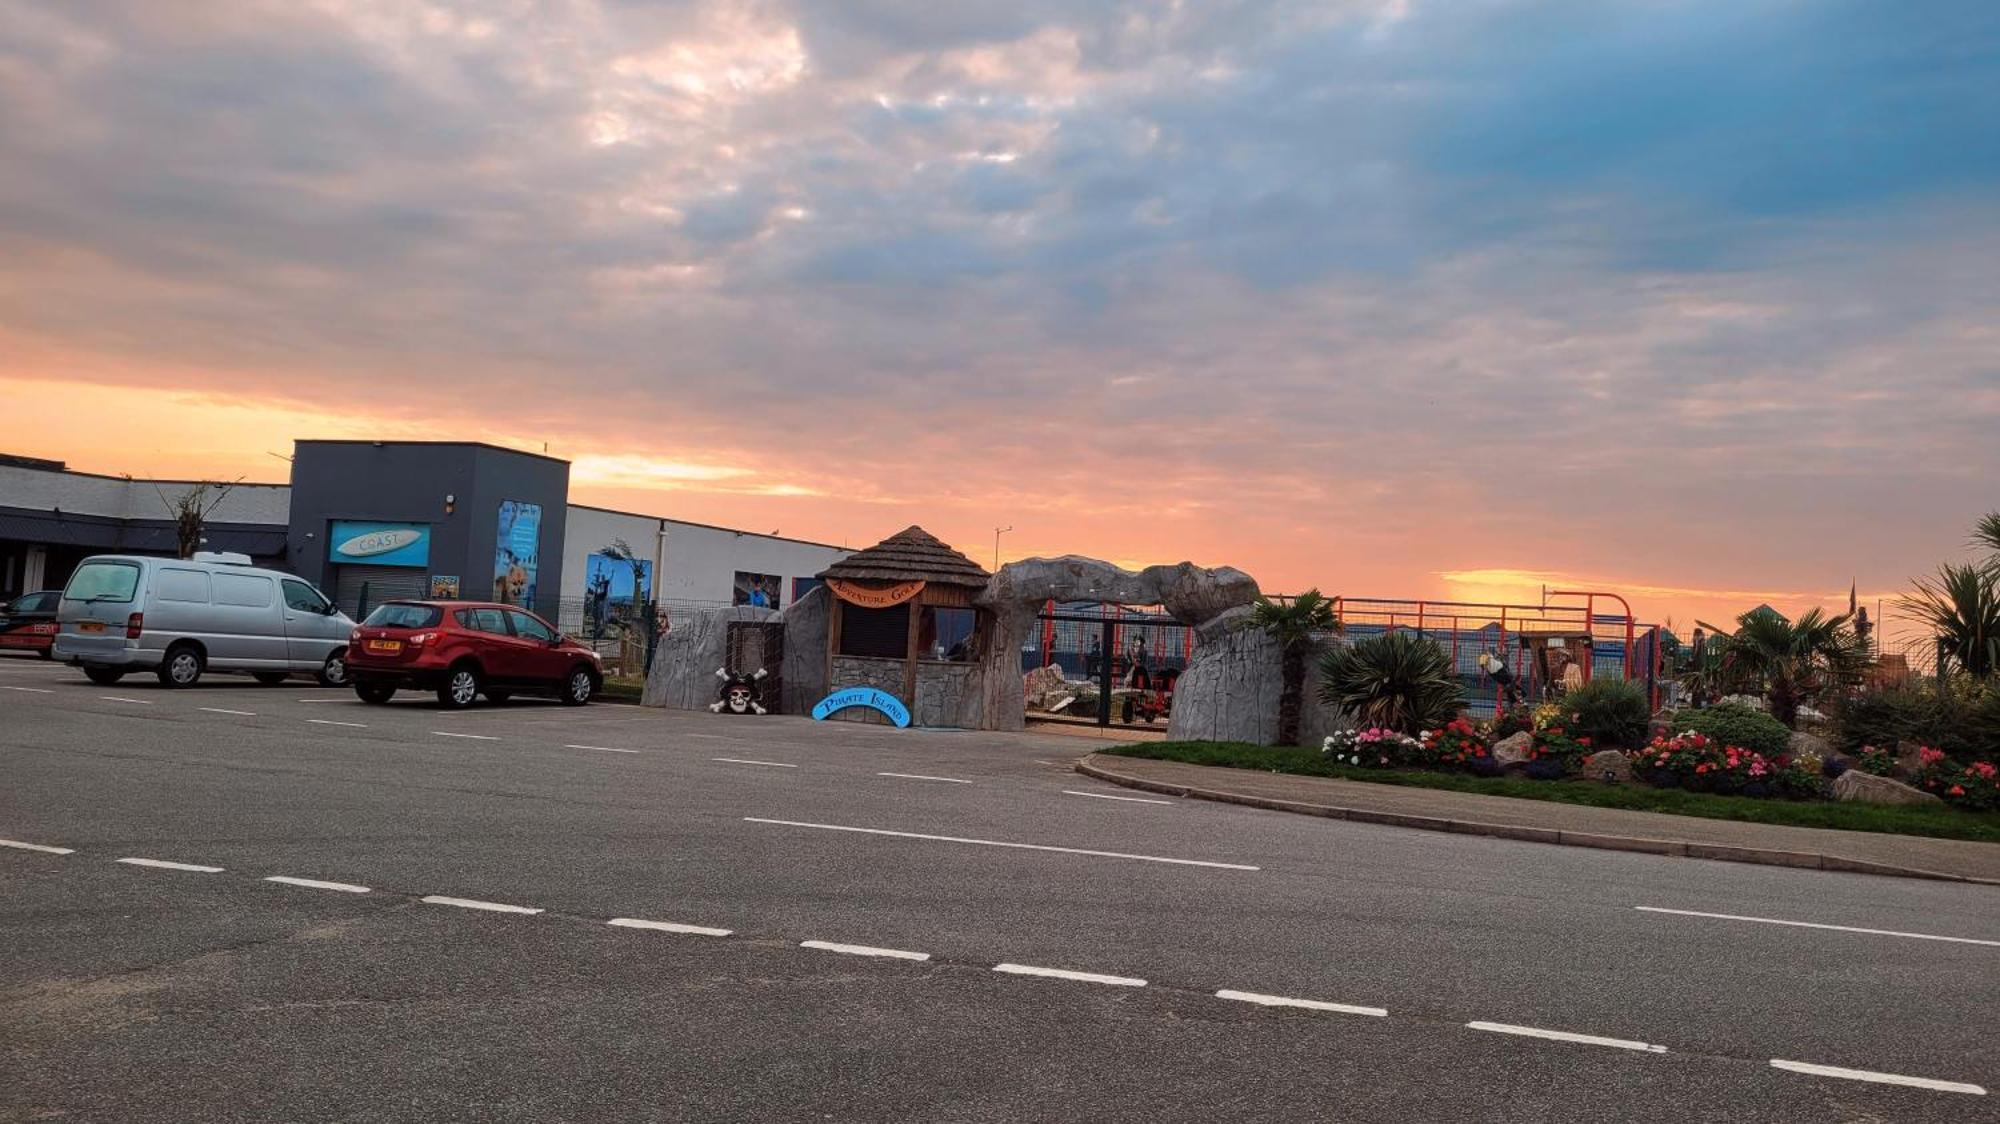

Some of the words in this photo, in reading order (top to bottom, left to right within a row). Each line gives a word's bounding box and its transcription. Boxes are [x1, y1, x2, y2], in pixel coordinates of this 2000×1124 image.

[359, 534, 399, 552] COAST
[834, 580, 887, 603] ADVENTURE
[891, 584, 916, 600] GOLF
[822, 694, 865, 711] PIRATE
[870, 692, 903, 720] ISLAND
